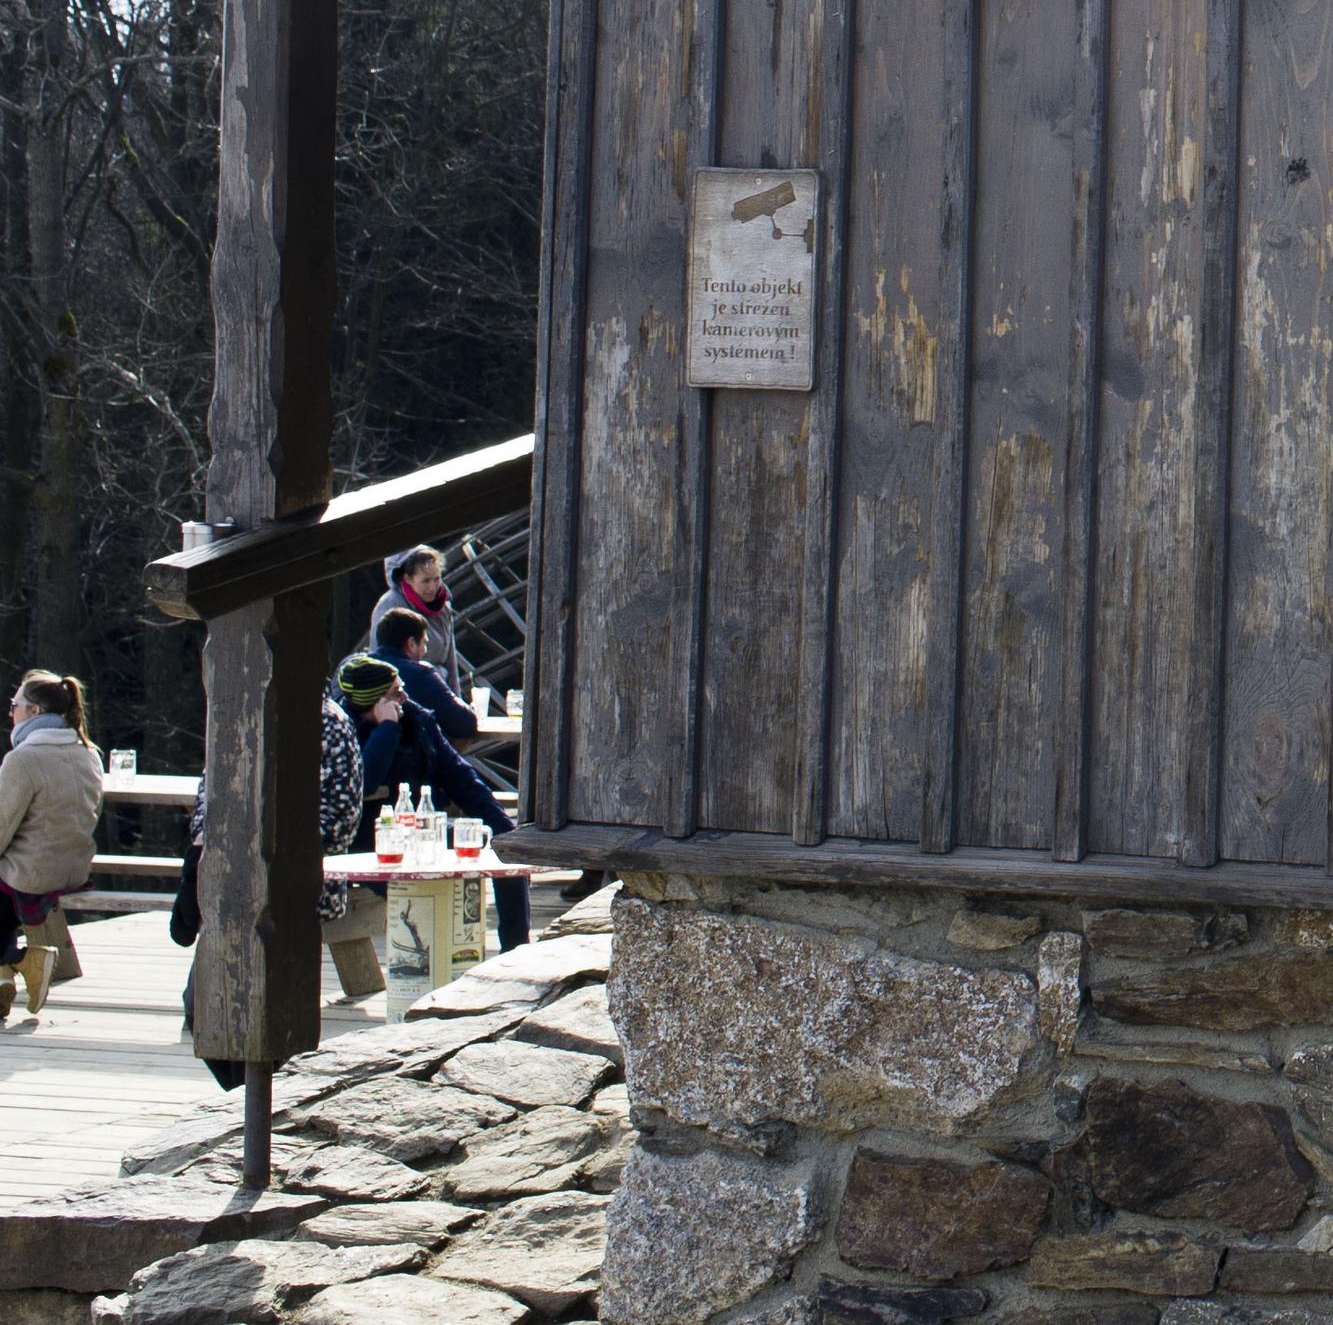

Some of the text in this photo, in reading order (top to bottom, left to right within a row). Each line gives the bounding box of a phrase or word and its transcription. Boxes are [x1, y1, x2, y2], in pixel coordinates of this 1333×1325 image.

[702, 277, 803, 300] Tento objekt
[712, 299, 726, 320] je
[702, 319, 800, 343] kamerovým
